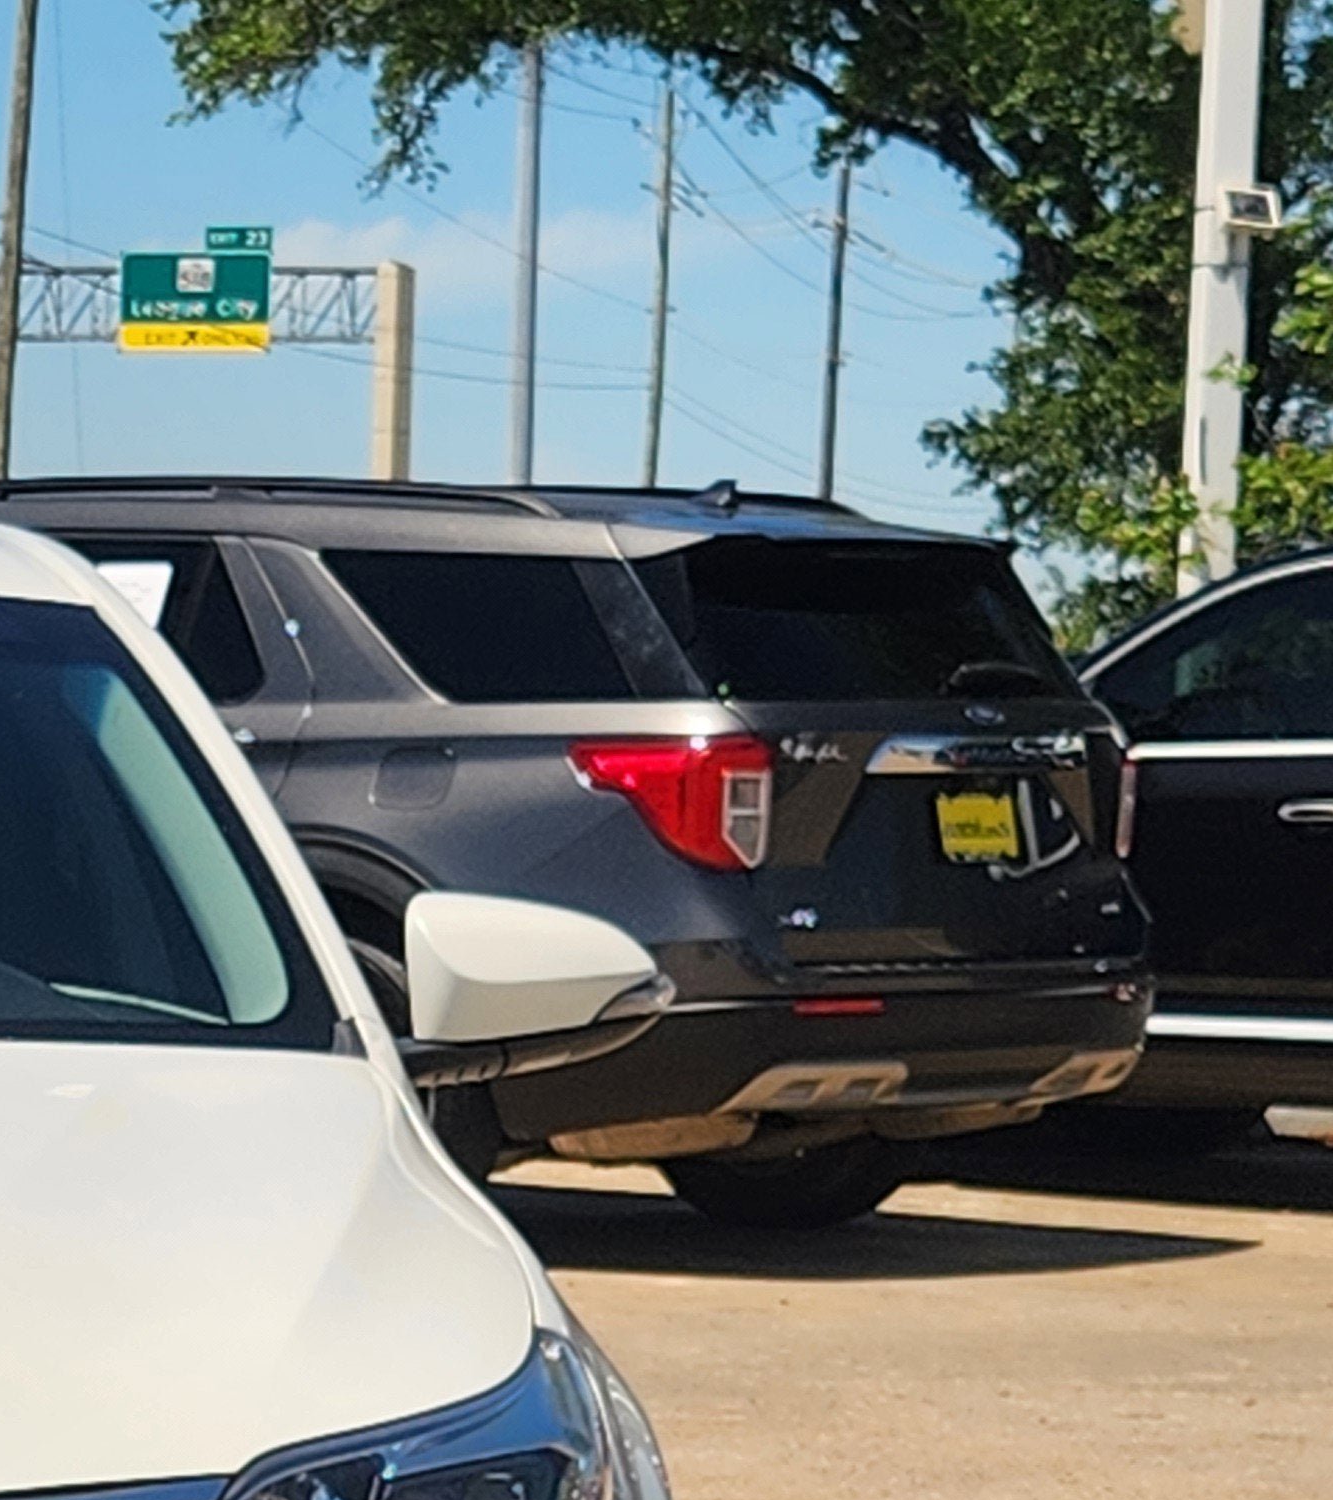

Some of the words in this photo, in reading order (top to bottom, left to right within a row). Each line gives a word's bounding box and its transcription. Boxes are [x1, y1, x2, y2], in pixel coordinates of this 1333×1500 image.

[245, 230, 268, 247] 23
[130, 299, 207, 321] League
[215, 298, 259, 321] City
